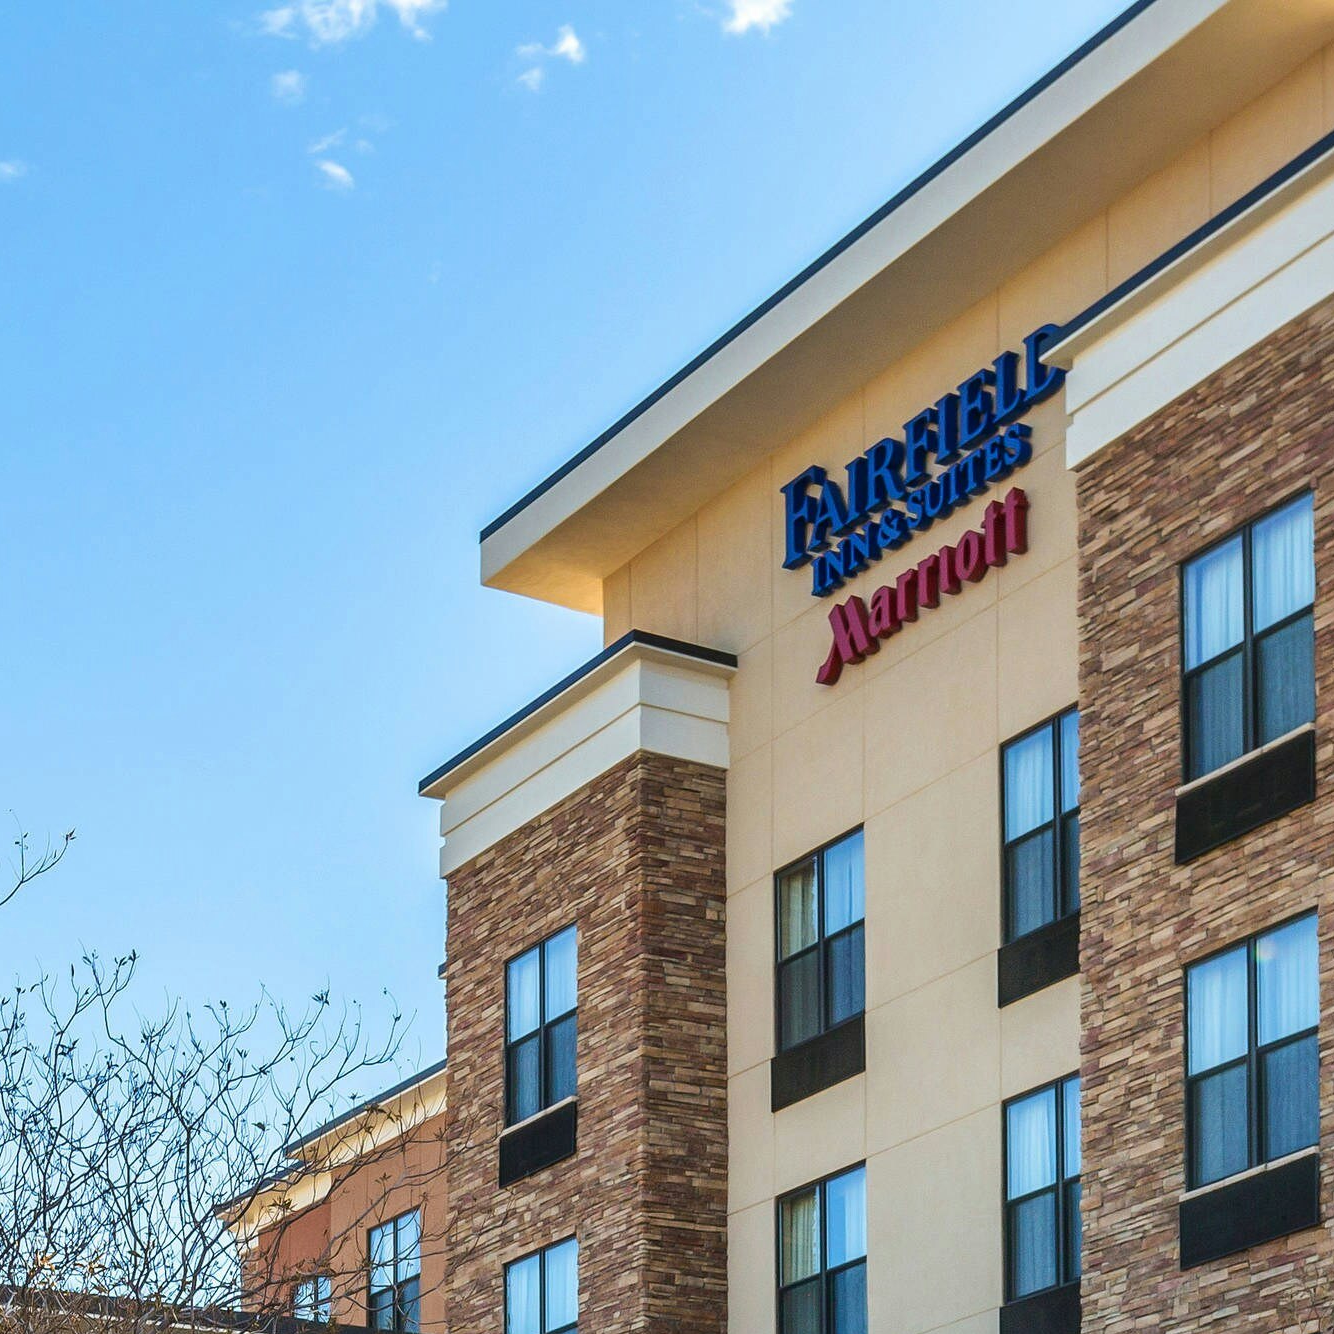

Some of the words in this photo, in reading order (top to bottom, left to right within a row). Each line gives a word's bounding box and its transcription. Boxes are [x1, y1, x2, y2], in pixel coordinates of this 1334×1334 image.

[779, 323, 1069, 571] FAIRFIELD
[811, 520, 883, 598] INN
[877, 508, 913, 551] &
[905, 422, 1033, 532] SUITES
[815, 486, 1031, 687] Marriott
